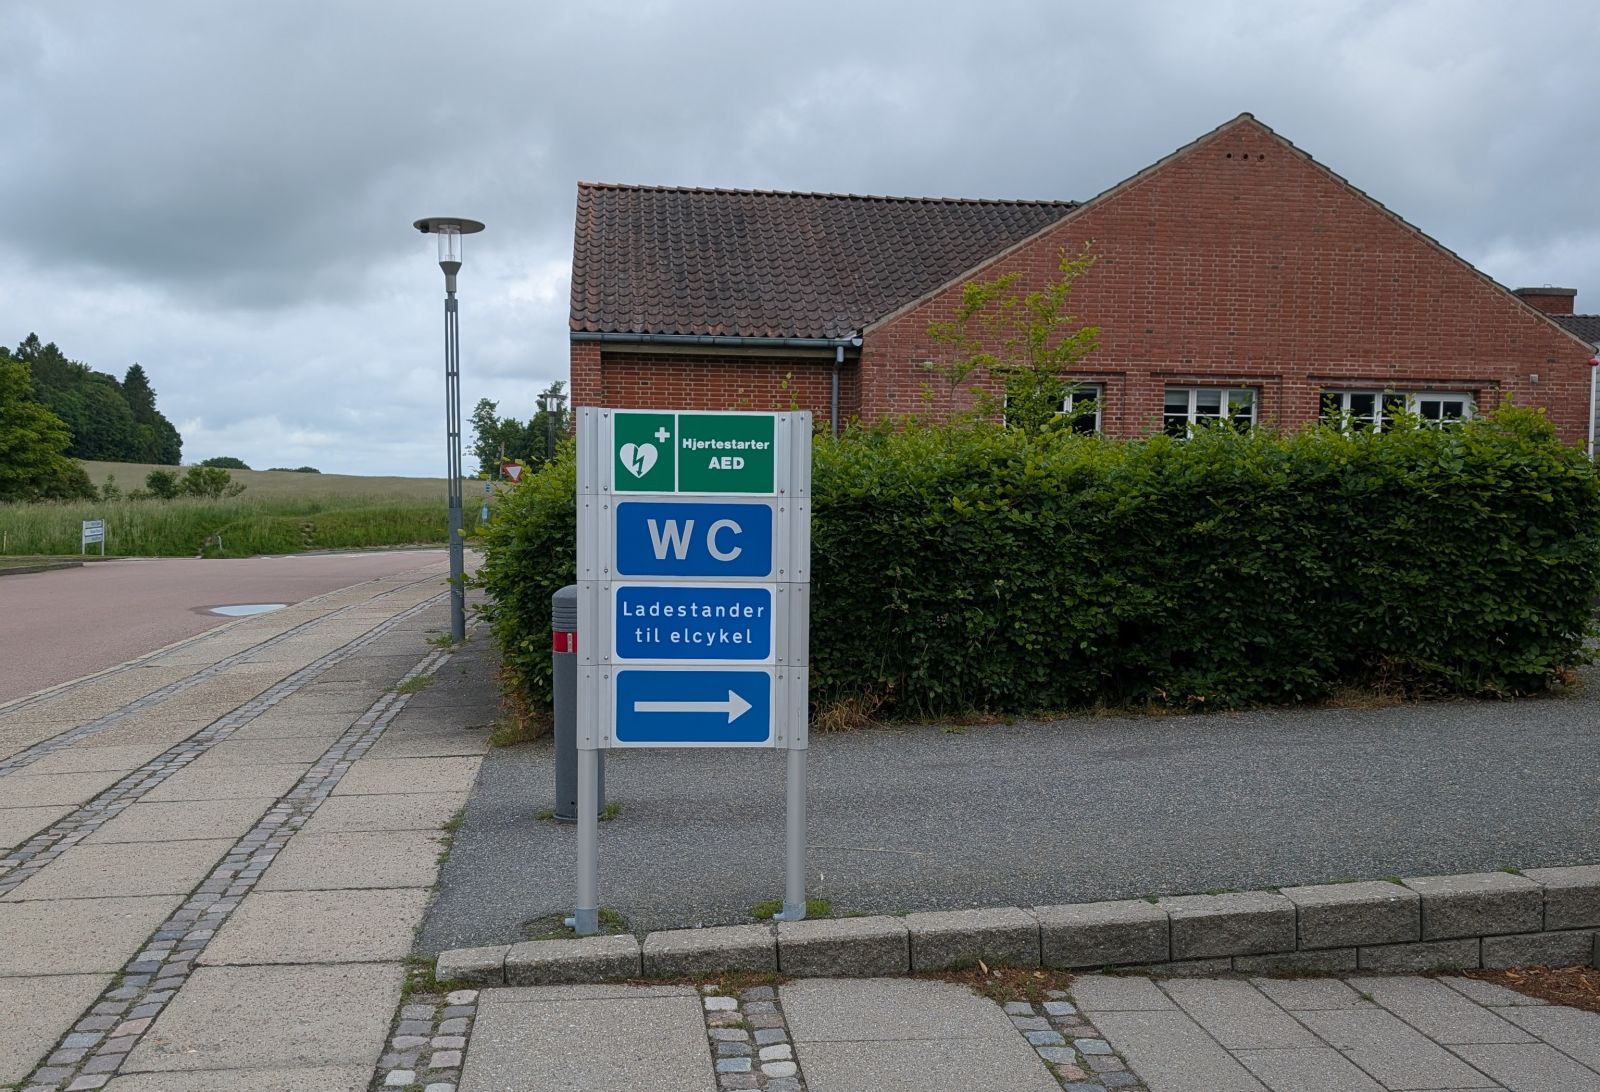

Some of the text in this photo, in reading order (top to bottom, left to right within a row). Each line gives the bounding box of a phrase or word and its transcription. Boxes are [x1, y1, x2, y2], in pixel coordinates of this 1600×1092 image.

[682, 438, 770, 451] Hjertestarter
[708, 456, 745, 470] AED
[623, 601, 765, 618] Ladestander
[635, 628, 753, 646] til elcykel
